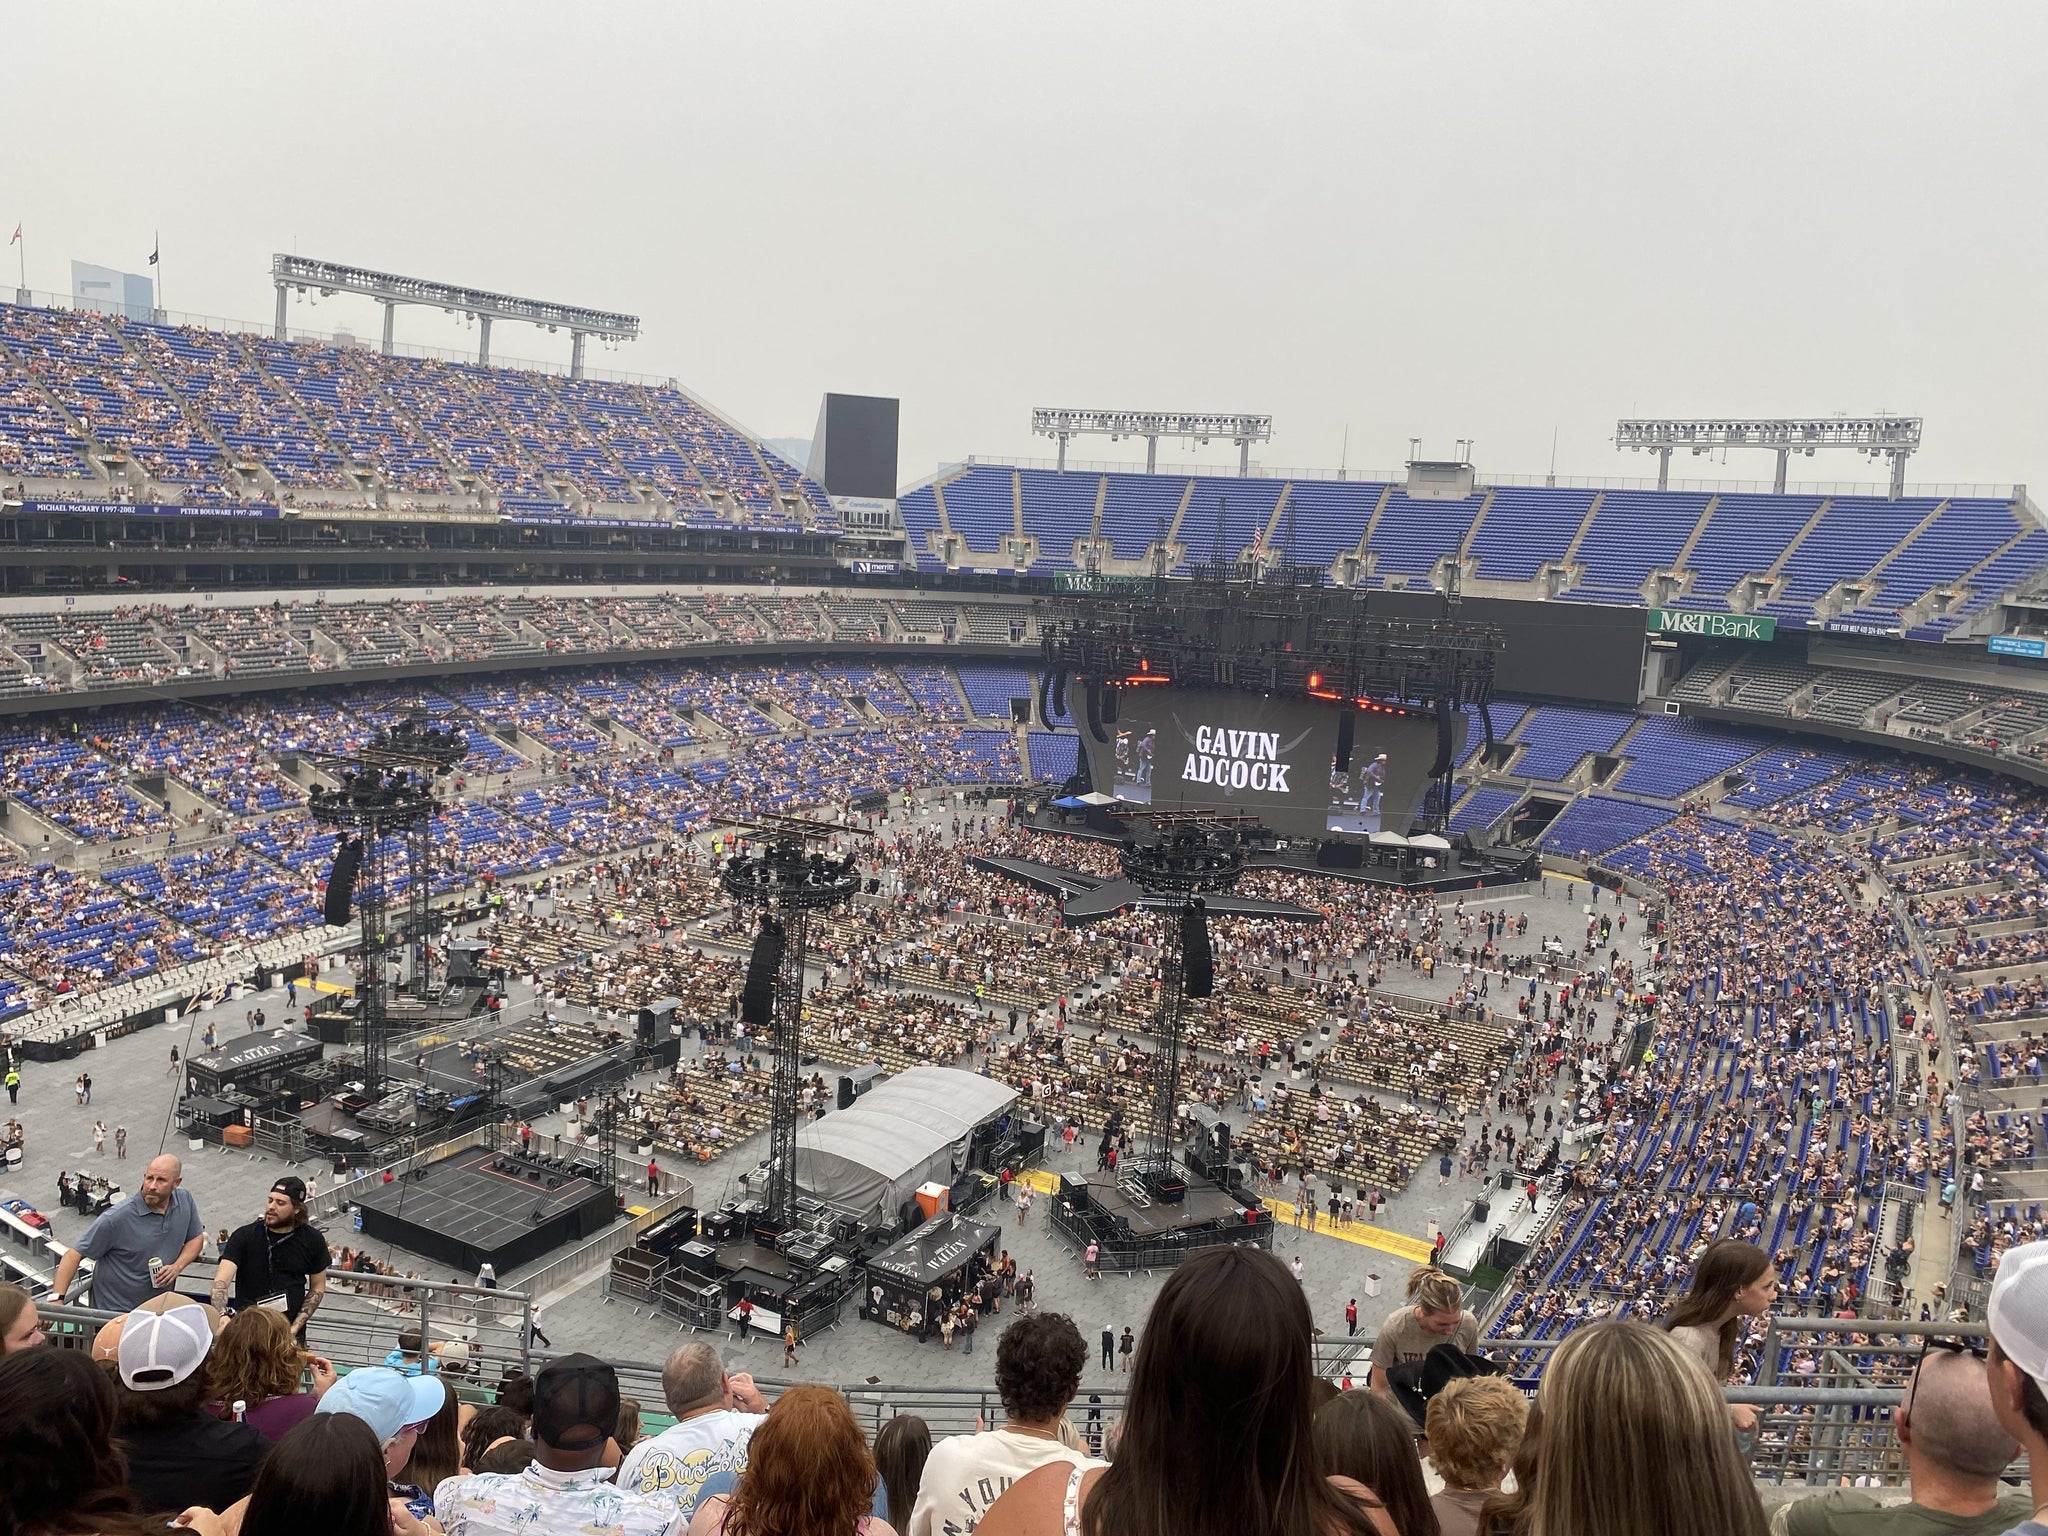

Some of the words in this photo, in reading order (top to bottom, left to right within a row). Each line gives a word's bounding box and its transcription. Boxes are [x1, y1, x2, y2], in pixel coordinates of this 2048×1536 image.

[37, 504, 67, 512] MICHAEL
[69, 504, 99, 513] McCRARY
[180, 507, 199, 515] PETER
[200, 508, 232, 516] BOULWARE
[871, 563, 895, 571] merritt
[1659, 610, 1711, 634] M&T
[1711, 615, 1761, 639] Bank
[1830, 623, 1841, 631] TEXT
[1841, 624, 1850, 632] FOR
[1850, 625, 1860, 633] HELP
[1195, 724, 1280, 761] GAVIN
[1181, 753, 1291, 793] ADCOCK
[230, 1045, 282, 1065] WALLEN
[1411, 1065, 1420, 1075] A
[1043, 1085, 1050, 1096] G
[926, 1239, 968, 1271] WALLEN
[881, 1260, 920, 1278] WALLEN
